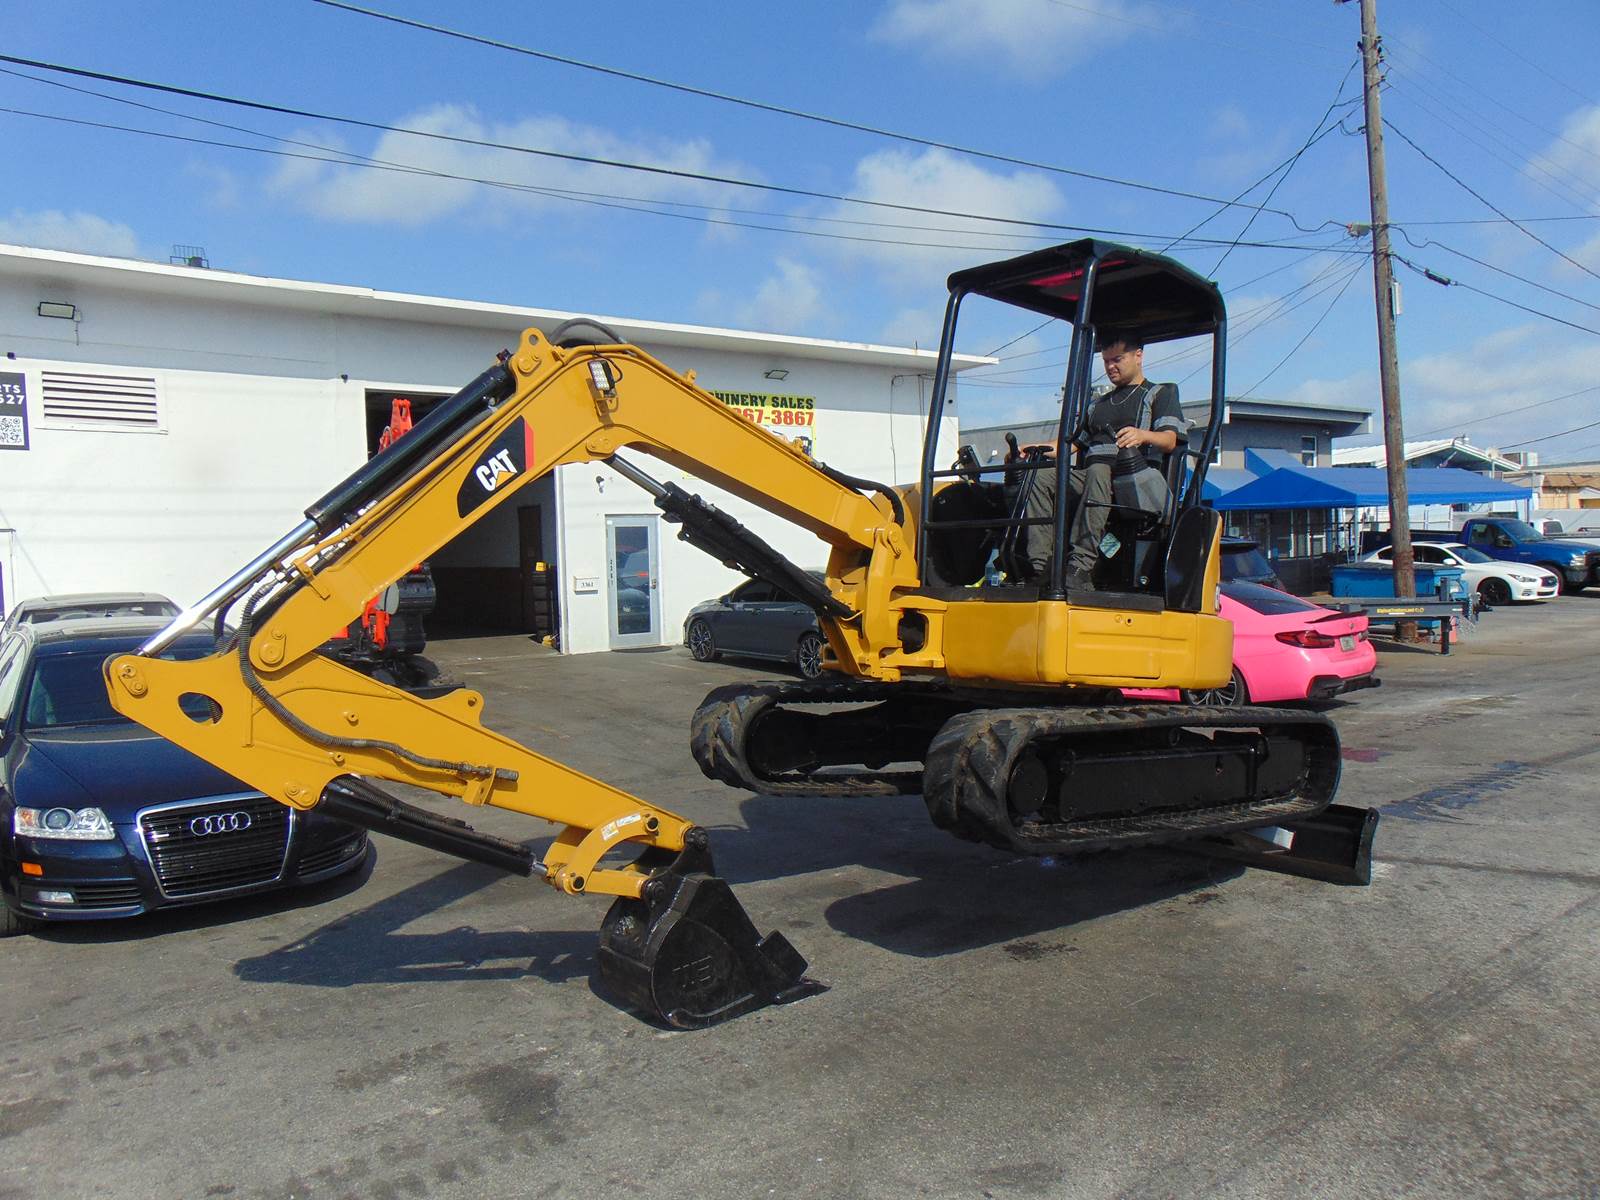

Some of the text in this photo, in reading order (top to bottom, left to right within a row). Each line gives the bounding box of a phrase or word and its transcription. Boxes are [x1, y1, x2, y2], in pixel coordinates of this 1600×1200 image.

[0, 384, 21, 394] TS
[708, 392, 813, 409] HINERY SALES
[476, 448, 518, 492] CAT
